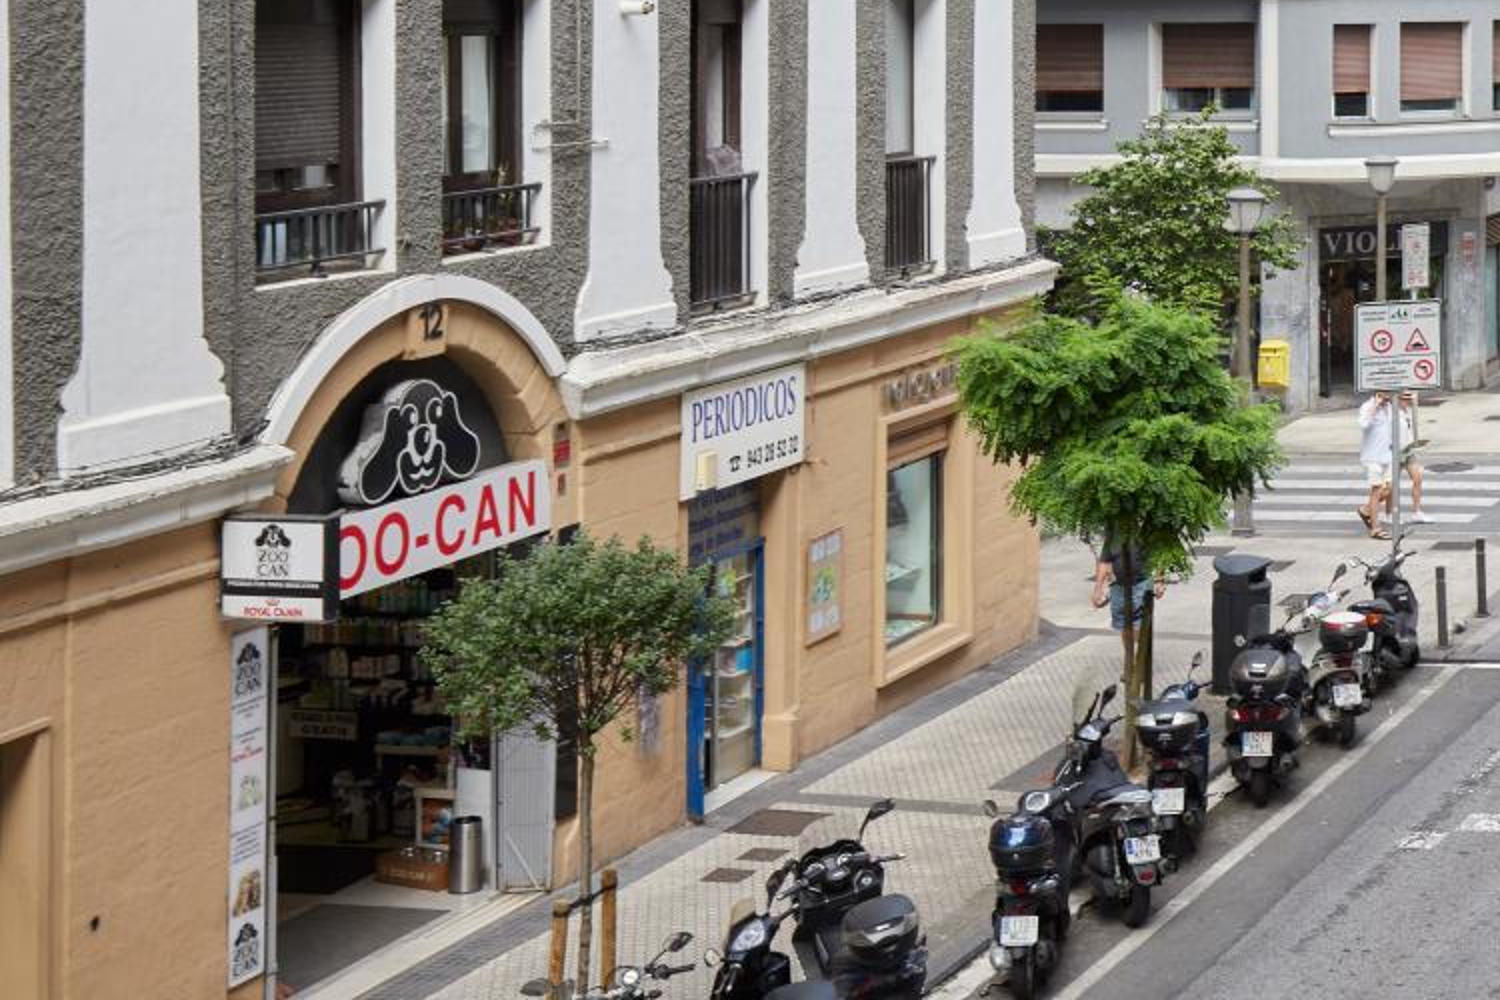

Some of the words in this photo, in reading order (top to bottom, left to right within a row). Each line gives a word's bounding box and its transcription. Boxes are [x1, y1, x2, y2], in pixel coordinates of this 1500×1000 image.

[419, 306, 443, 341] 12
[692, 375, 797, 443] PERIODICOS
[339, 471, 536, 591] OO-CAN
[257, 563, 289, 577] CAN
[258, 549, 289, 563] ZOO
